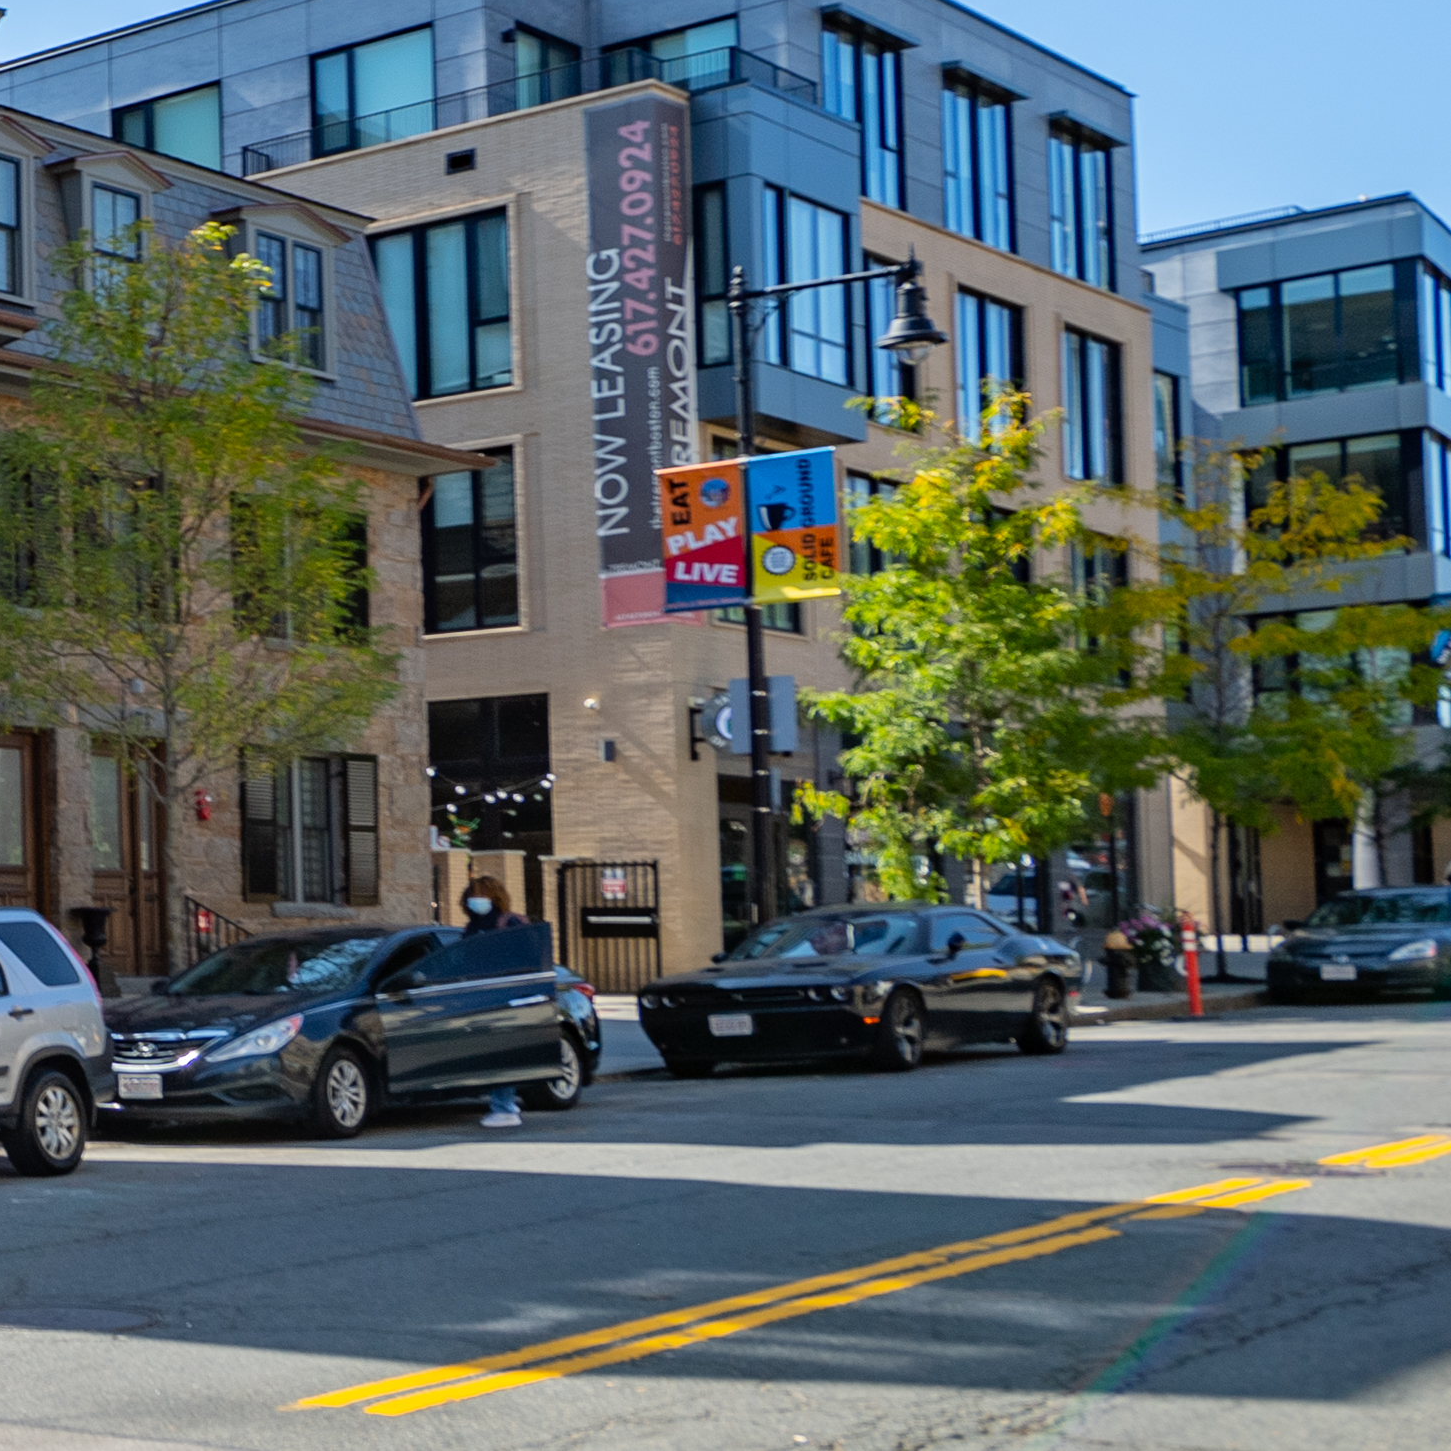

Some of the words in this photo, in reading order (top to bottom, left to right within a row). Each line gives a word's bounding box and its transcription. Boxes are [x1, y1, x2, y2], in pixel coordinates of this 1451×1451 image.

[617, 120, 660, 356] 617.427.0924
[586, 248, 626, 421] LEASING
[664, 277, 693, 466] REMONT
[593, 434, 630, 537] NOW
[669, 478, 692, 526] EAT
[796, 458, 816, 528] GROUND
[666, 516, 738, 556] PLAY
[802, 532, 817, 581] SOLID
[819, 537, 834, 580] CAFE
[674, 561, 739, 584] LIVE
